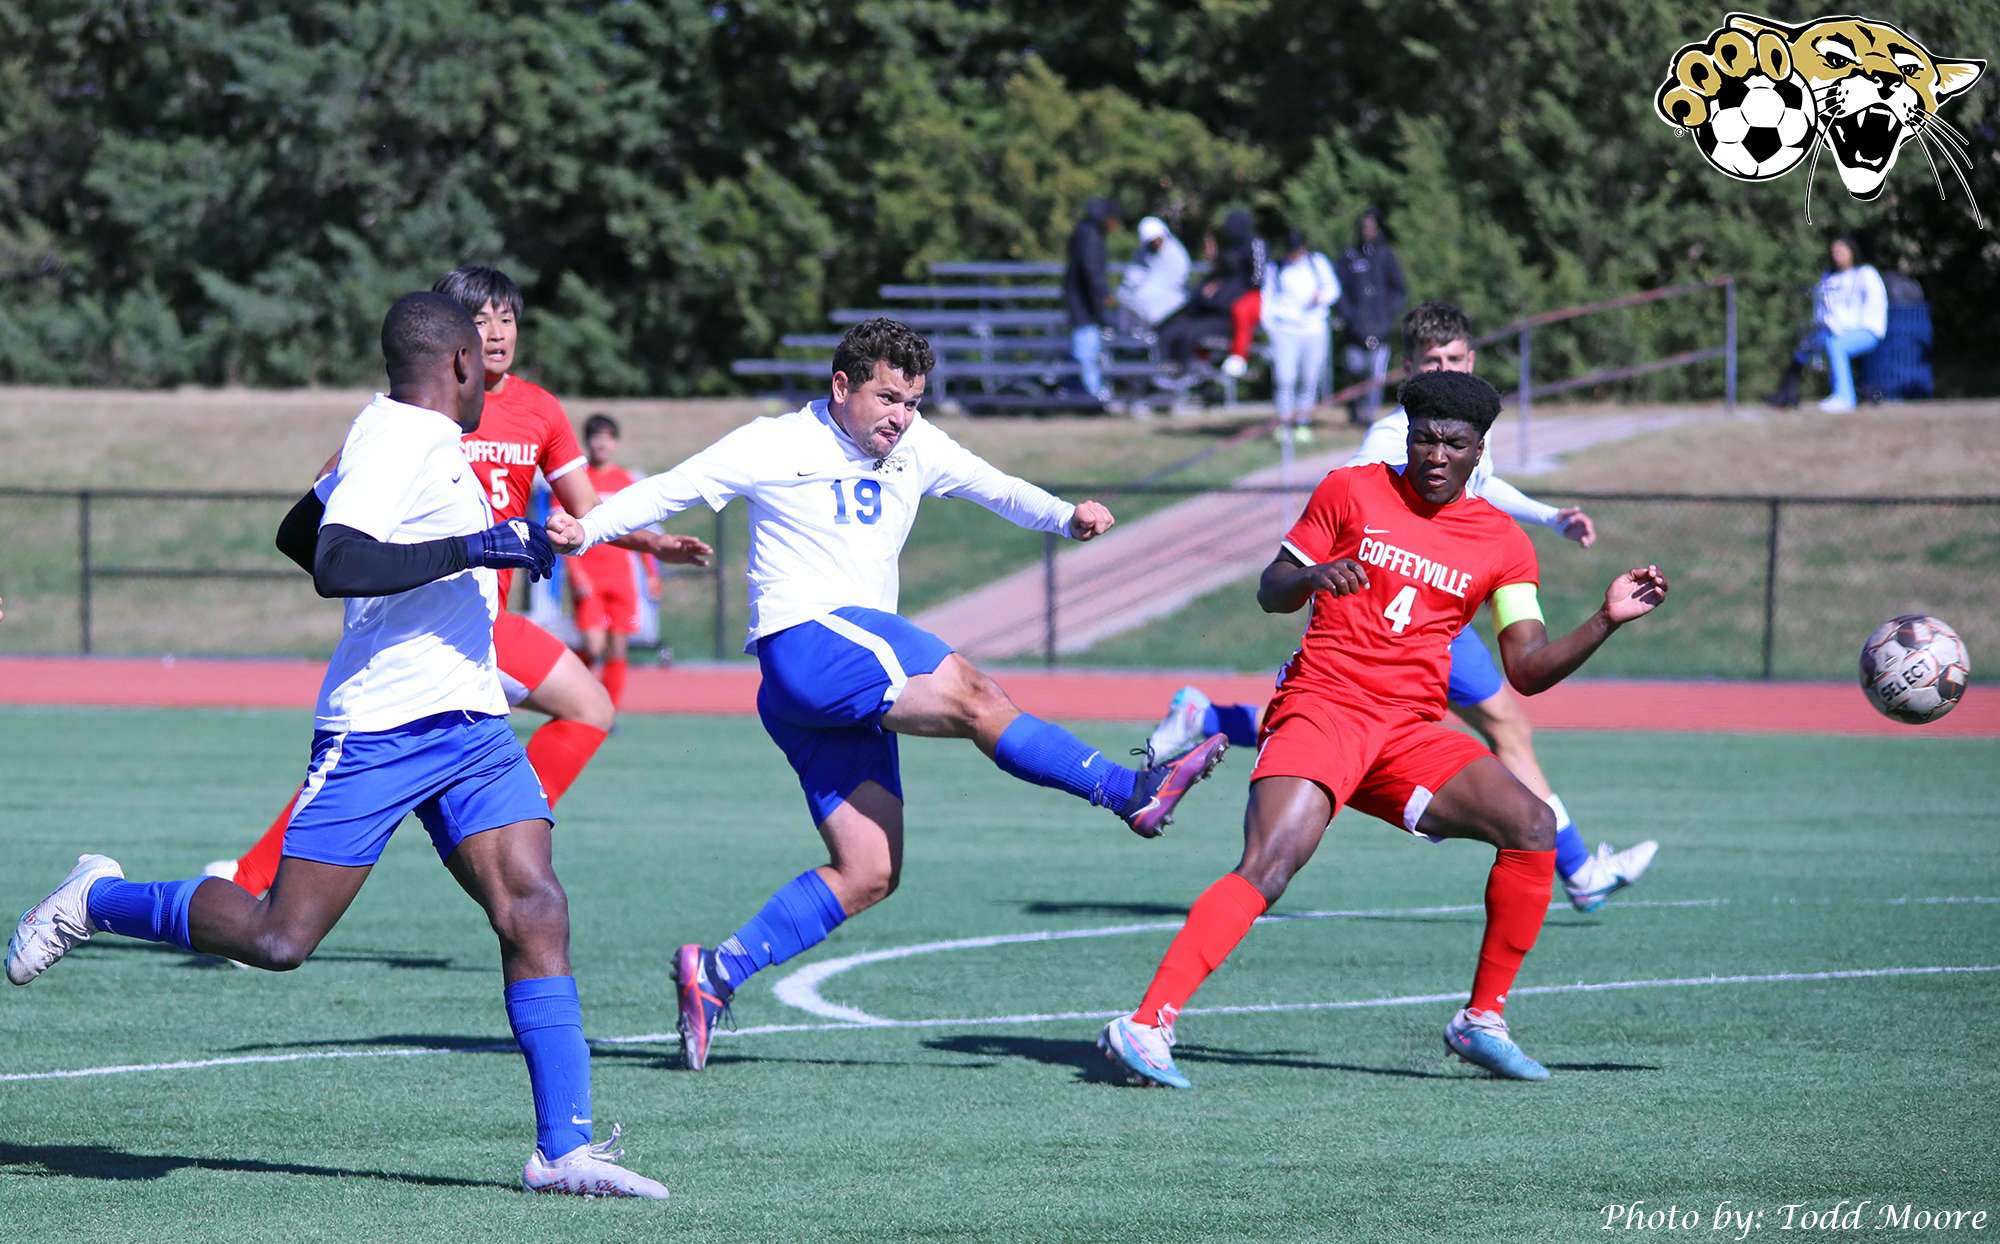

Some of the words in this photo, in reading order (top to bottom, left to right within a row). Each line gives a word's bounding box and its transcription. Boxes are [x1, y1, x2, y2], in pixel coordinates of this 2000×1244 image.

[490, 468, 510, 510] 5
[831, 479, 882, 524] 19
[1358, 537, 1472, 598] COFFEYVILLE
[1384, 585, 1417, 633] 4
[1880, 657, 1931, 702] SELECT
